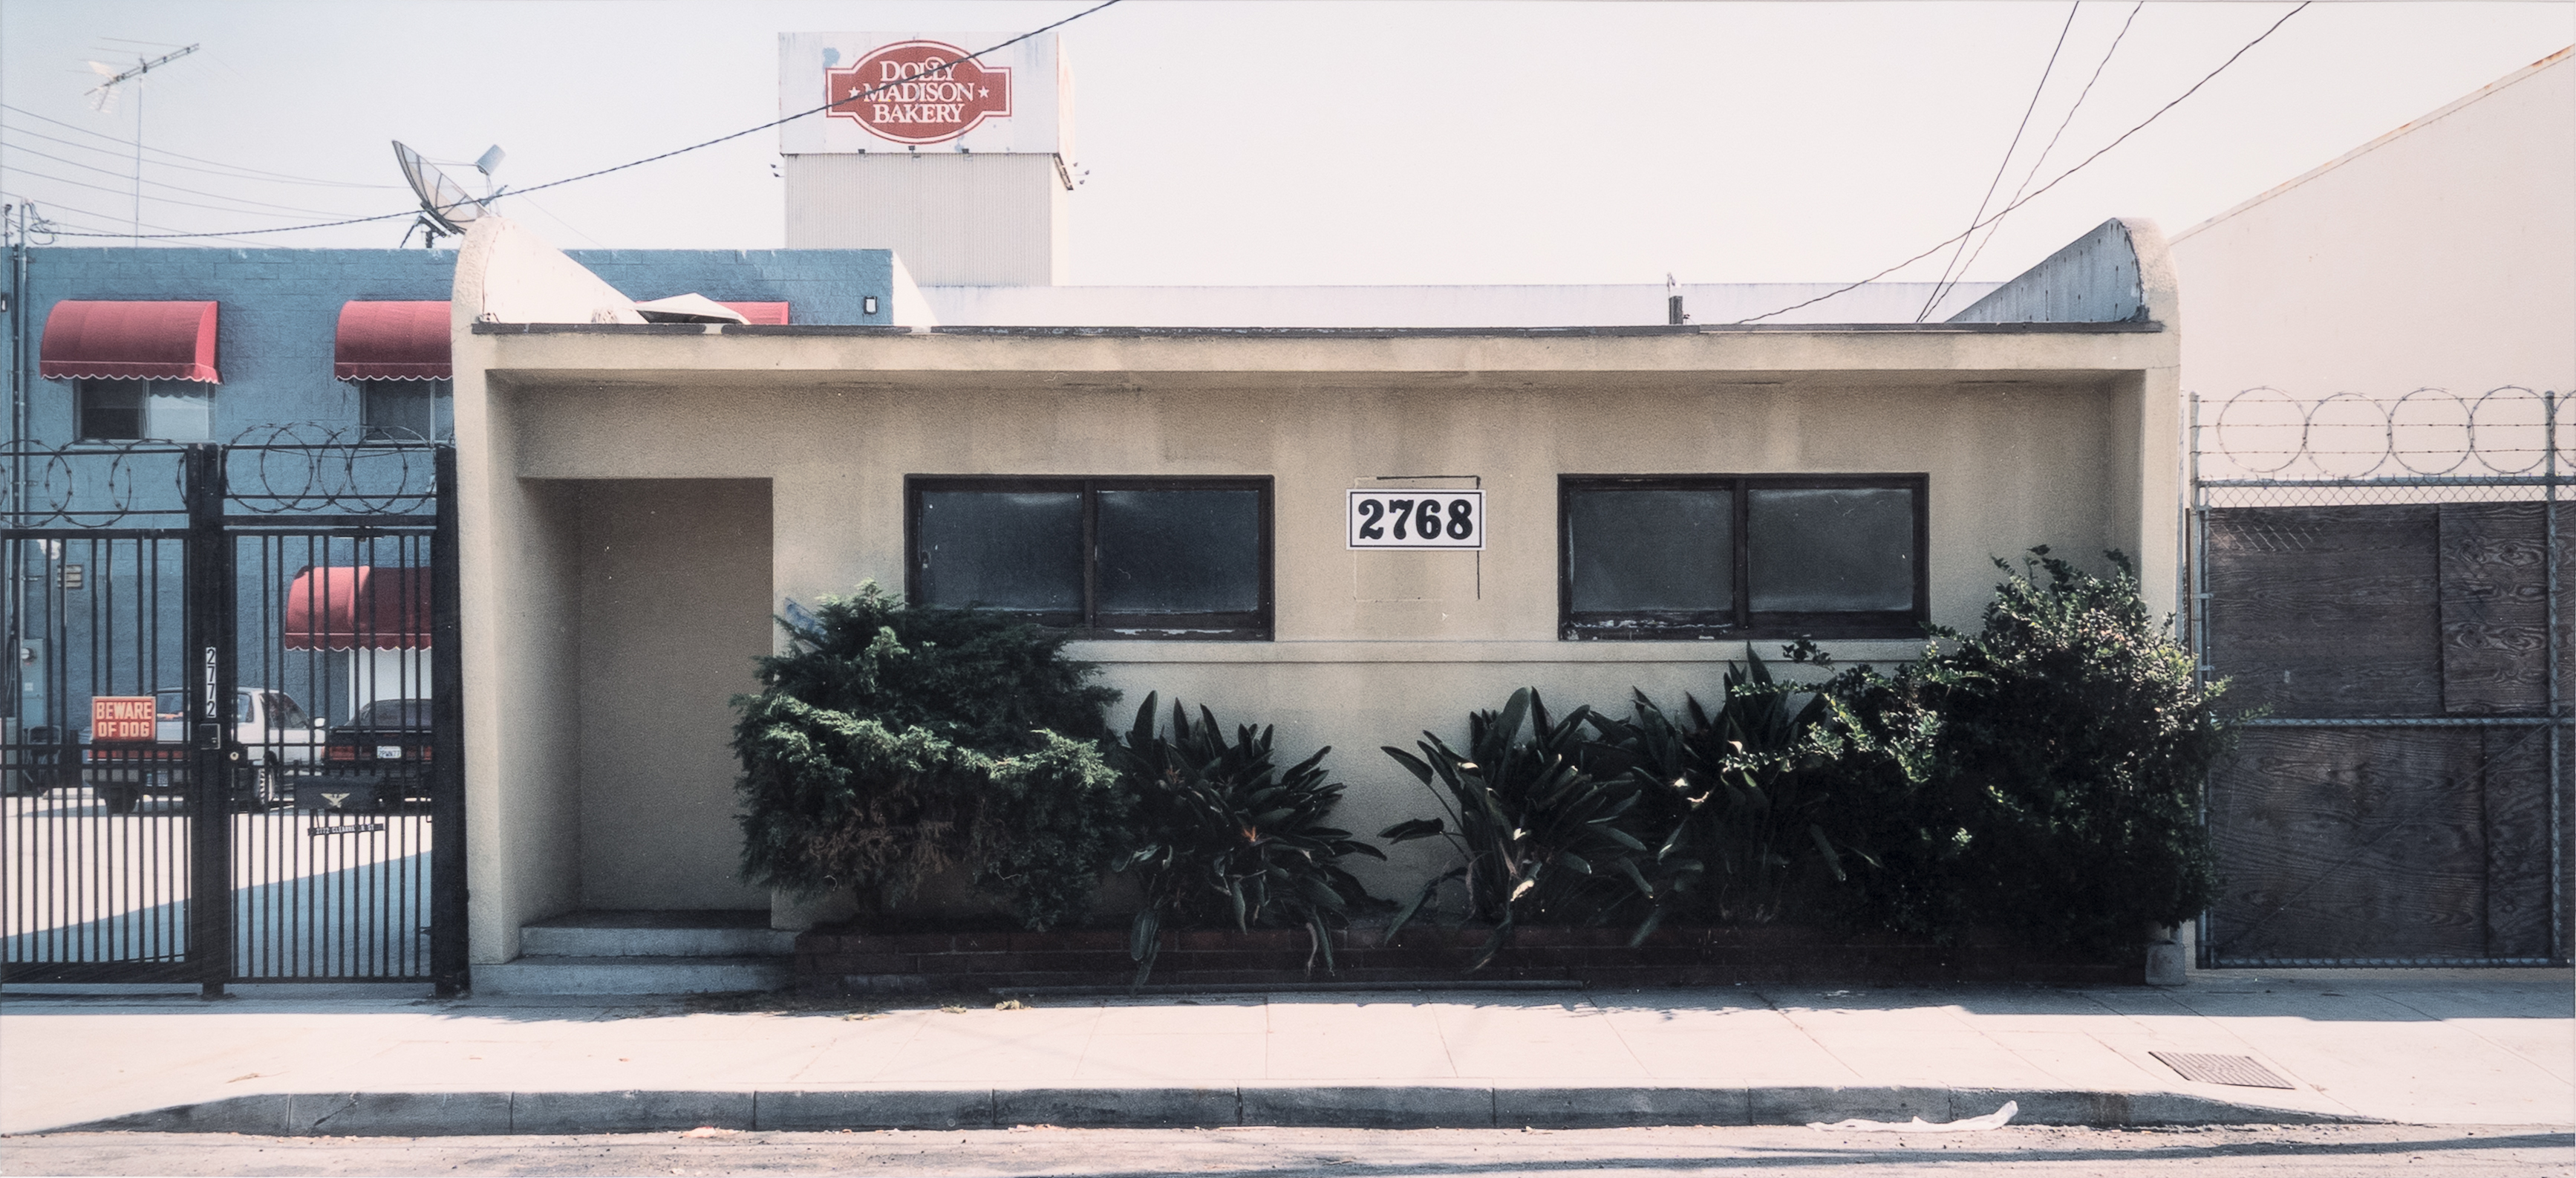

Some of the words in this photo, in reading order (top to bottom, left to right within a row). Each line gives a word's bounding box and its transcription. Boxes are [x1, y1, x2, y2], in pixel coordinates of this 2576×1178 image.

[879, 56, 959, 82] DOLLY
[863, 82, 975, 102] MADISON
[873, 103, 965, 123] BAKERY
[1358, 498, 1473, 540] 2768
[207, 648, 215, 717] 2772
[96, 701, 152, 720] BEWARE
[98, 721, 117, 738] OF
[120, 721, 150, 738] DOG
[316, 827, 330, 835] 2772
